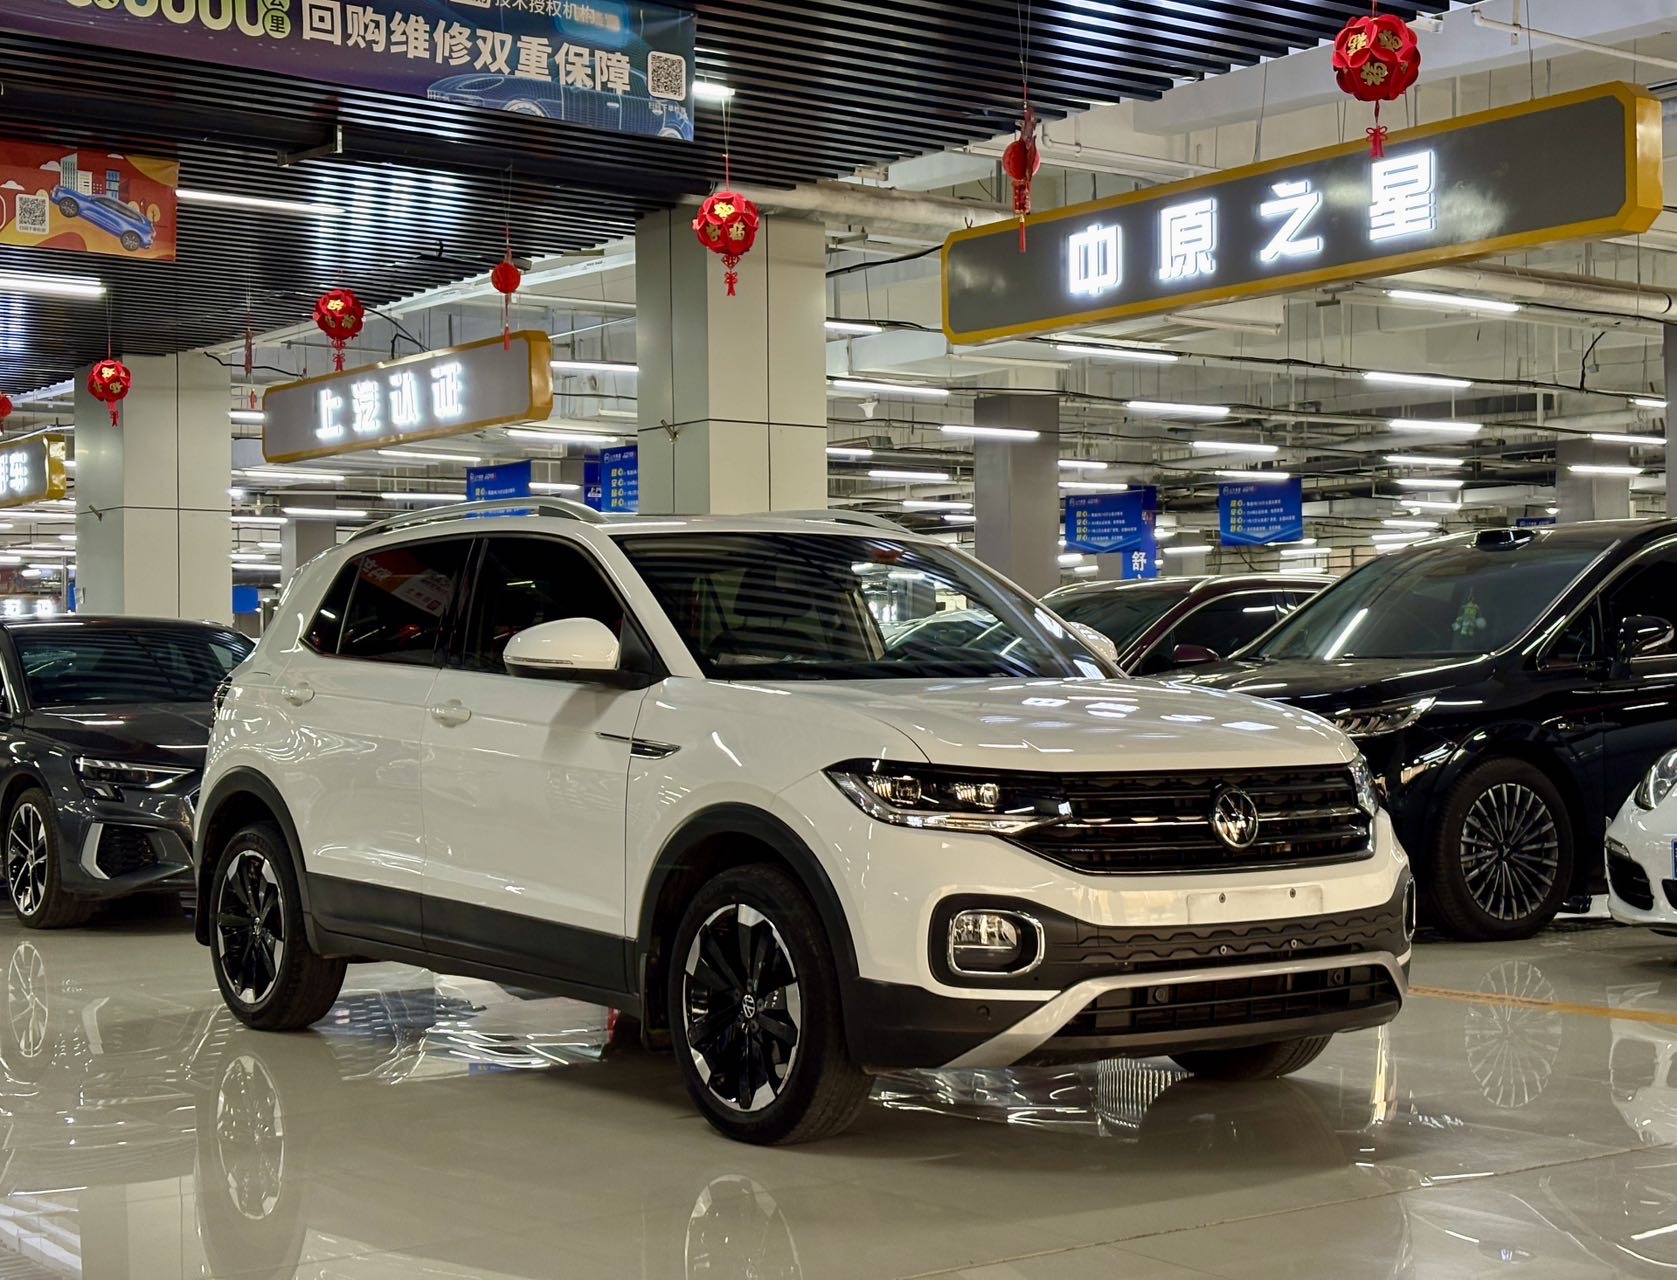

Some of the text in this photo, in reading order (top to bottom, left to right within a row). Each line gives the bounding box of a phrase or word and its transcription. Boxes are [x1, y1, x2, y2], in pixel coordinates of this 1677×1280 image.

[302, 0, 631, 95] 回购维修双重保障
[1067, 150, 1437, 297] 中原之星
